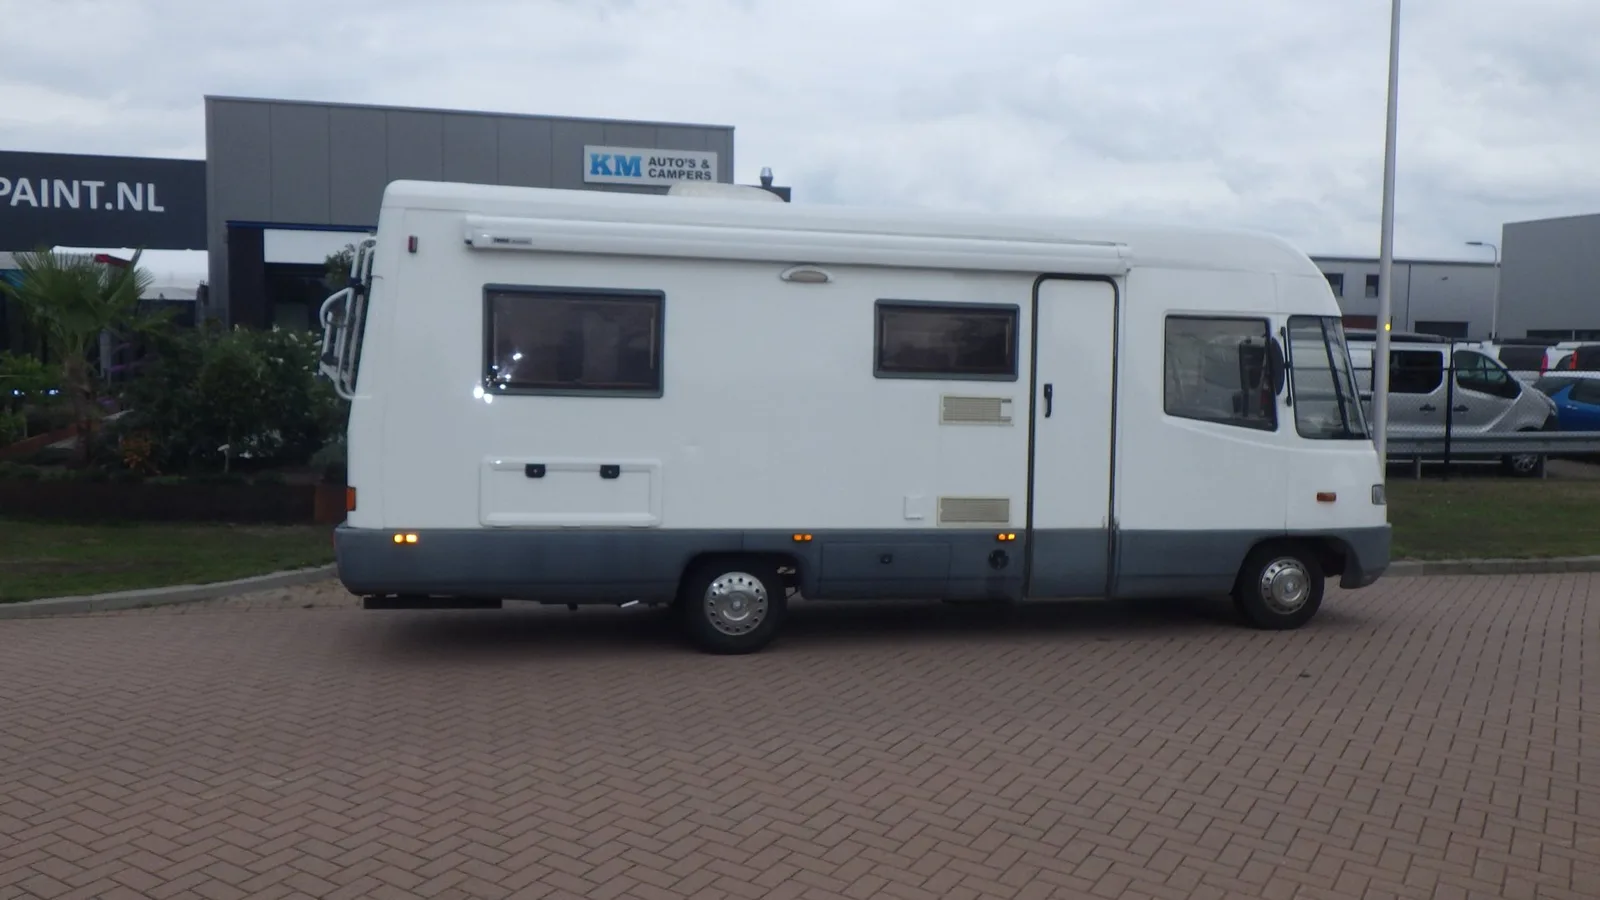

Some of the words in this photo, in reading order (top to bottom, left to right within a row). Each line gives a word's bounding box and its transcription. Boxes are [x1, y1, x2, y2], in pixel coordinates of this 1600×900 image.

[590, 153, 642, 177] KM
[648, 157, 696, 168] AUTO'S
[701, 159, 710, 169] &
[648, 169, 712, 181] CAMPERS
